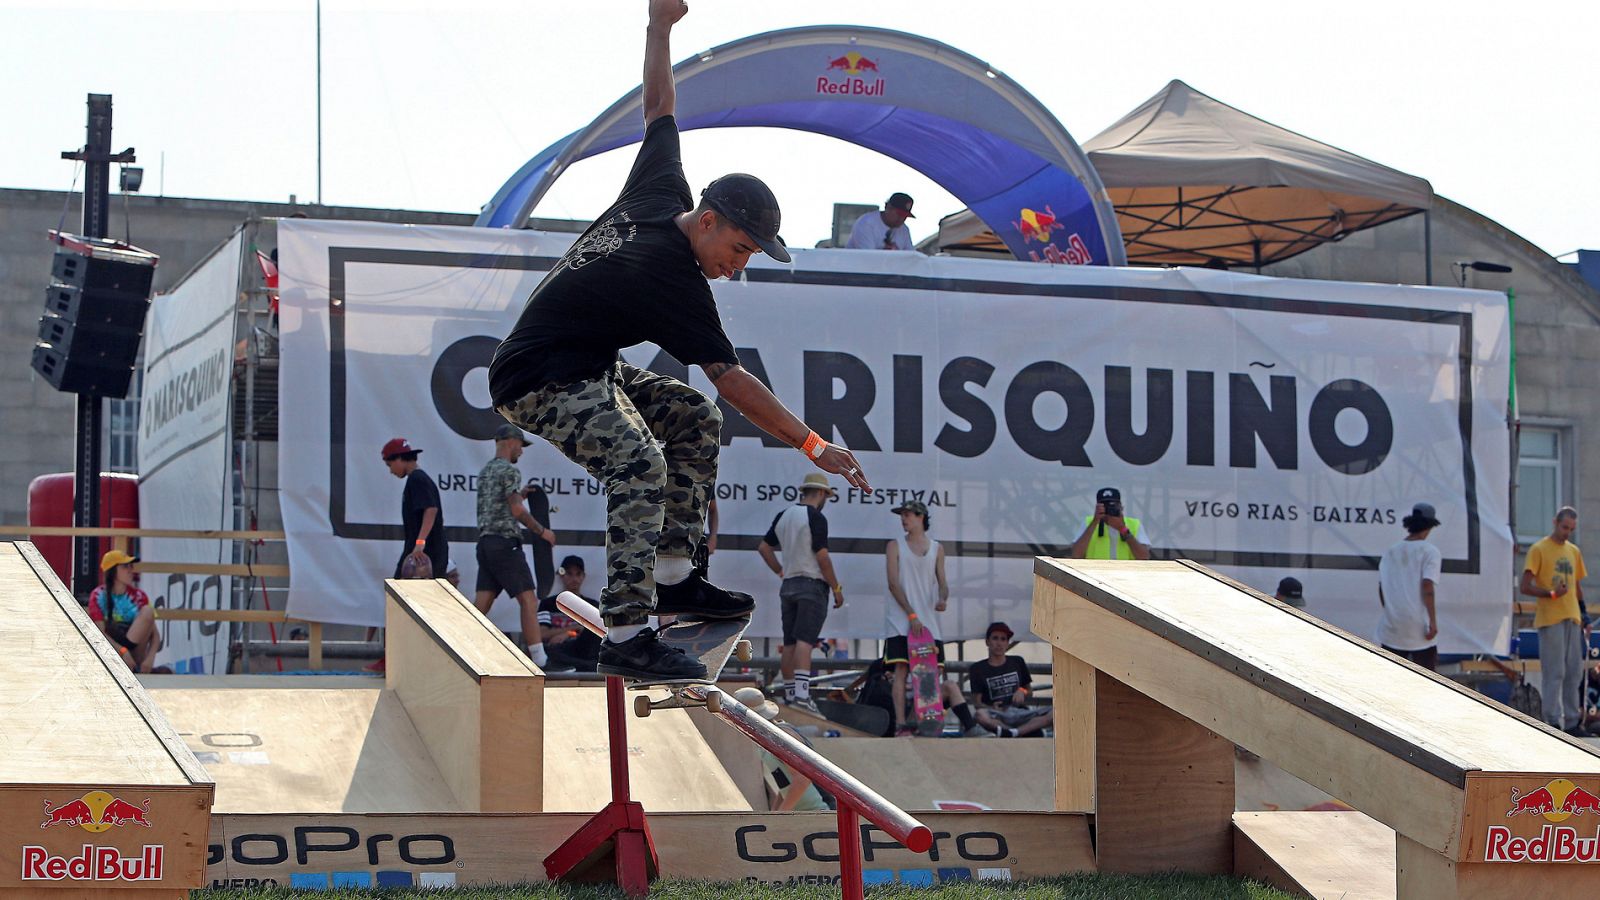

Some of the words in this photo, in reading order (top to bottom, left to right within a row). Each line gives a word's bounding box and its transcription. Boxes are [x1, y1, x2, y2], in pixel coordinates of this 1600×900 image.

[816, 76, 851, 95] Red
[852, 77, 886, 97] Bull
[756, 484, 839, 503] SPOS
[847, 487, 957, 507] FESTIVAL
[1185, 500, 1240, 518] VIGO
[1247, 503, 1299, 521] RIAS
[1313, 506, 1397, 525] BAIXAS
[1485, 825, 1553, 862] Red
[1551, 826, 1600, 862] Bu
[22, 844, 94, 880] Red
[95, 844, 164, 881] Bull
